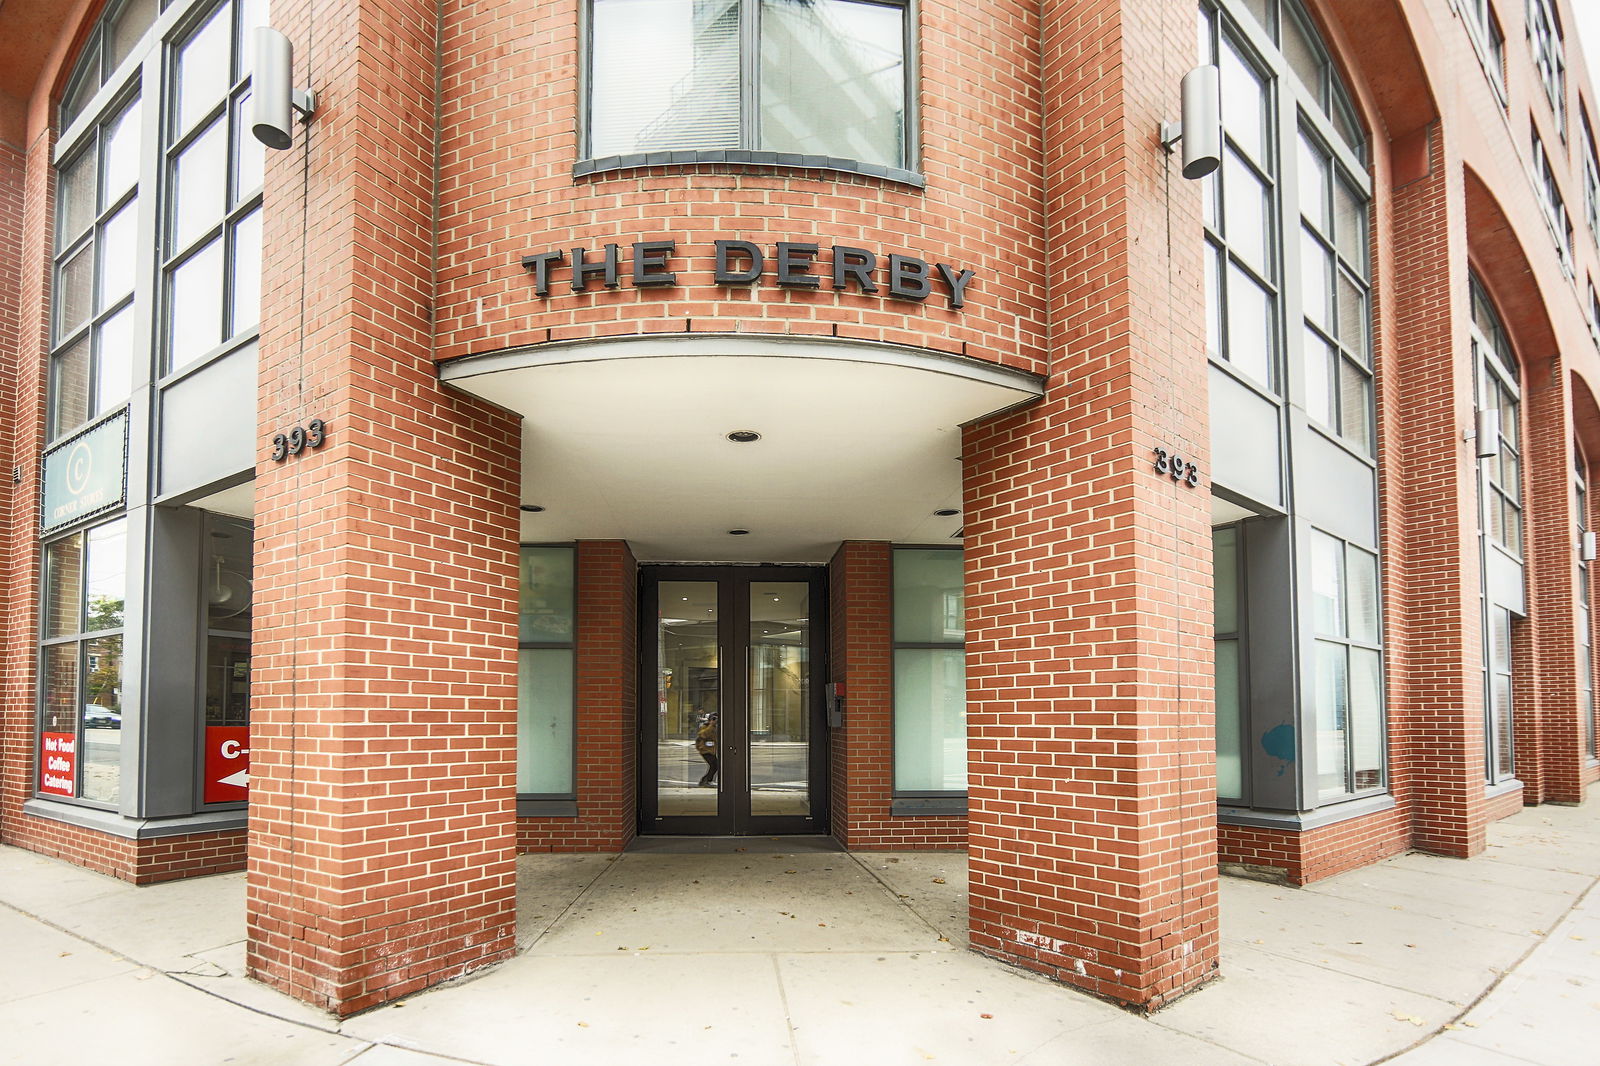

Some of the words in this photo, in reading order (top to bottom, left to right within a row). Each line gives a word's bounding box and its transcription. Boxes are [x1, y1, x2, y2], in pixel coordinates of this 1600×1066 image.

[521, 239, 676, 296] THE
[714, 240, 976, 309] DERBY
[271, 418, 325, 461] 393
[1153, 446, 1200, 488] 393
[45, 737, 57, 752] Hot
[58, 738, 75, 753] Food
[48, 756, 71, 772] Coffee
[44, 773, 73, 794] Catering
